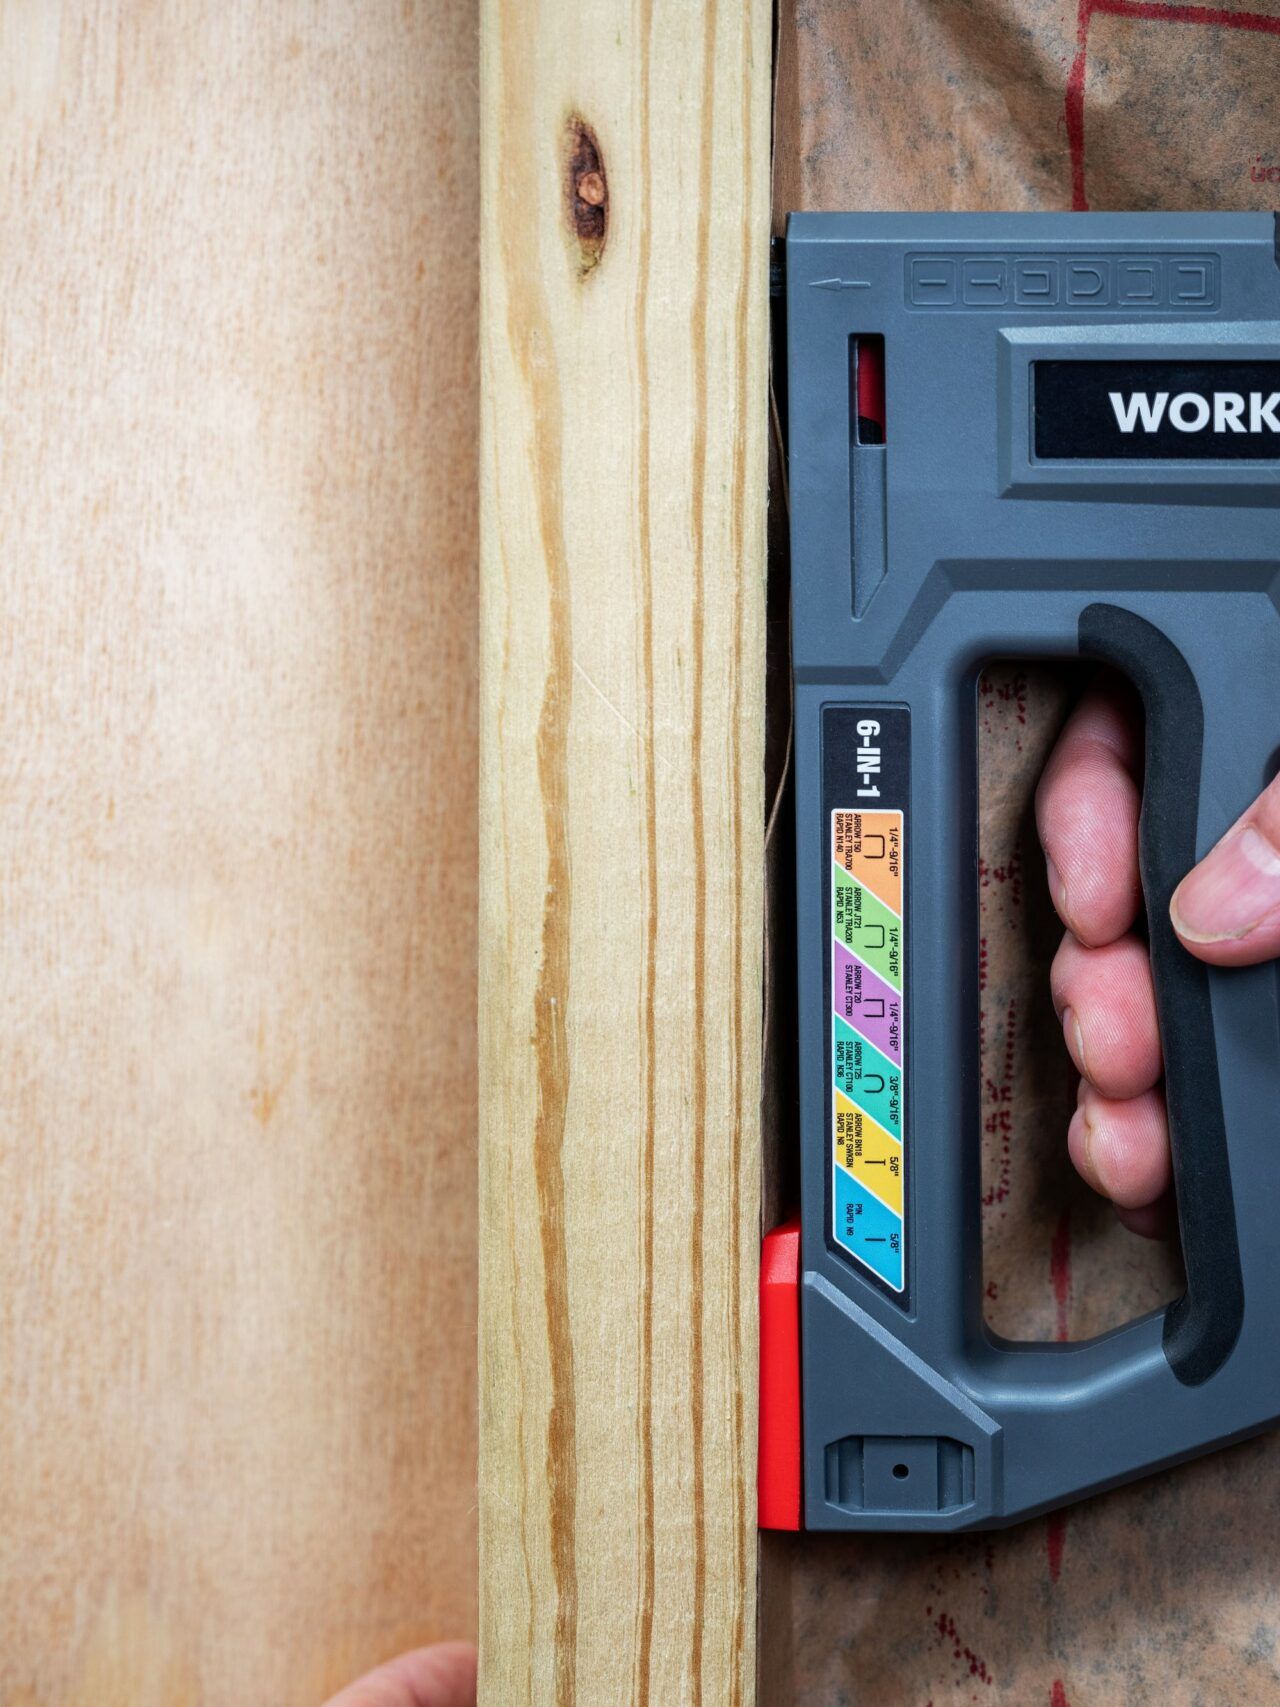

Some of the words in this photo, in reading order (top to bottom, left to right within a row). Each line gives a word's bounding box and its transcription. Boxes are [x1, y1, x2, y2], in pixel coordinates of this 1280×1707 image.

[856, 720, 881, 798] 6-IN-1
[853, 814, 861, 838] ARROW
[853, 840, 861, 853] T50
[836, 887, 844, 907] RAPID
[836, 911, 844, 923] N53
[836, 1113, 844, 1133] RAPID
[845, 1113, 853, 1142] STANLEY
[854, 1113, 862, 1138] ARROW
[845, 1144, 853, 1168] SWKBN
[854, 1139, 862, 1156] BN18
[889, 1156, 899, 1177] 5/8"
[854, 1204, 862, 1215] PIN
[889, 1233, 899, 1253] 5/8"
